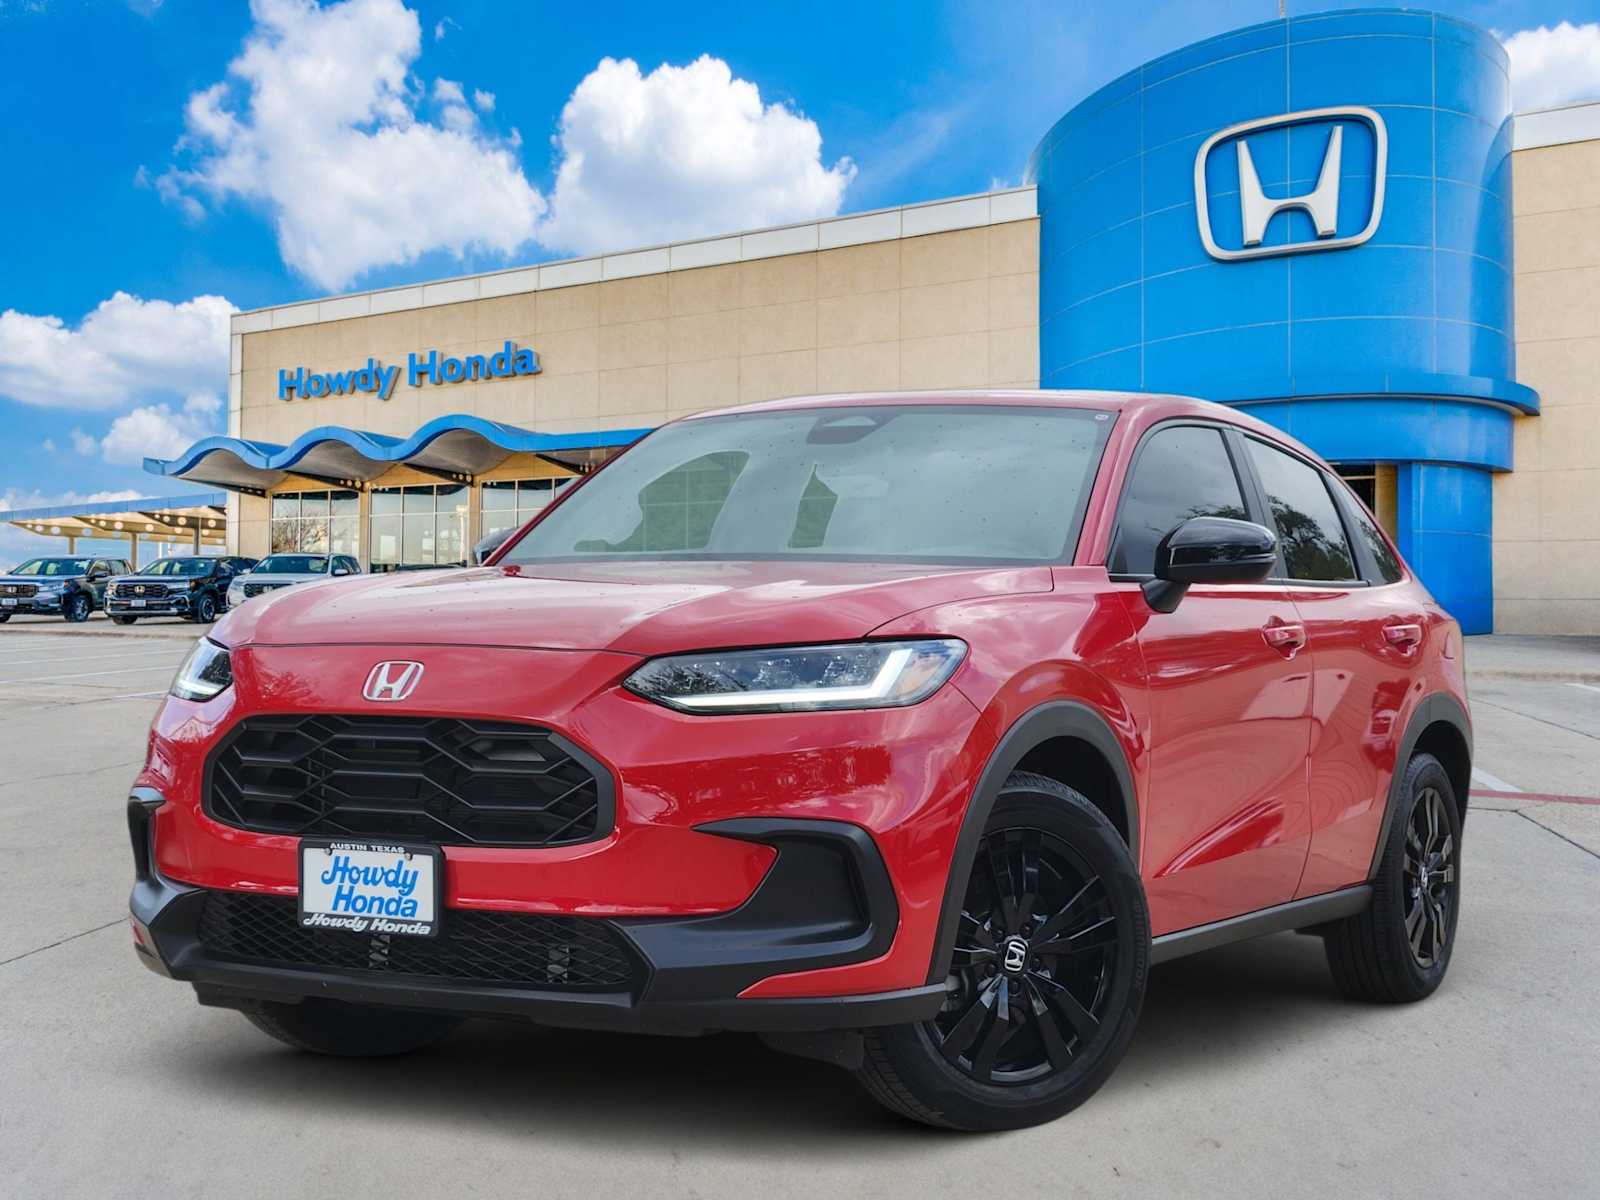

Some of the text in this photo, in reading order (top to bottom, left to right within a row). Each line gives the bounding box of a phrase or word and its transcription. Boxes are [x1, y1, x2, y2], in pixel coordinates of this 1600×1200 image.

[278, 340, 541, 400] Howdy Honda
[330, 842, 405, 853] AUSTIN TEXAS
[321, 855, 418, 896] Howdy
[332, 884, 418, 918] Honda
[303, 913, 431, 935] Howdy Honda
